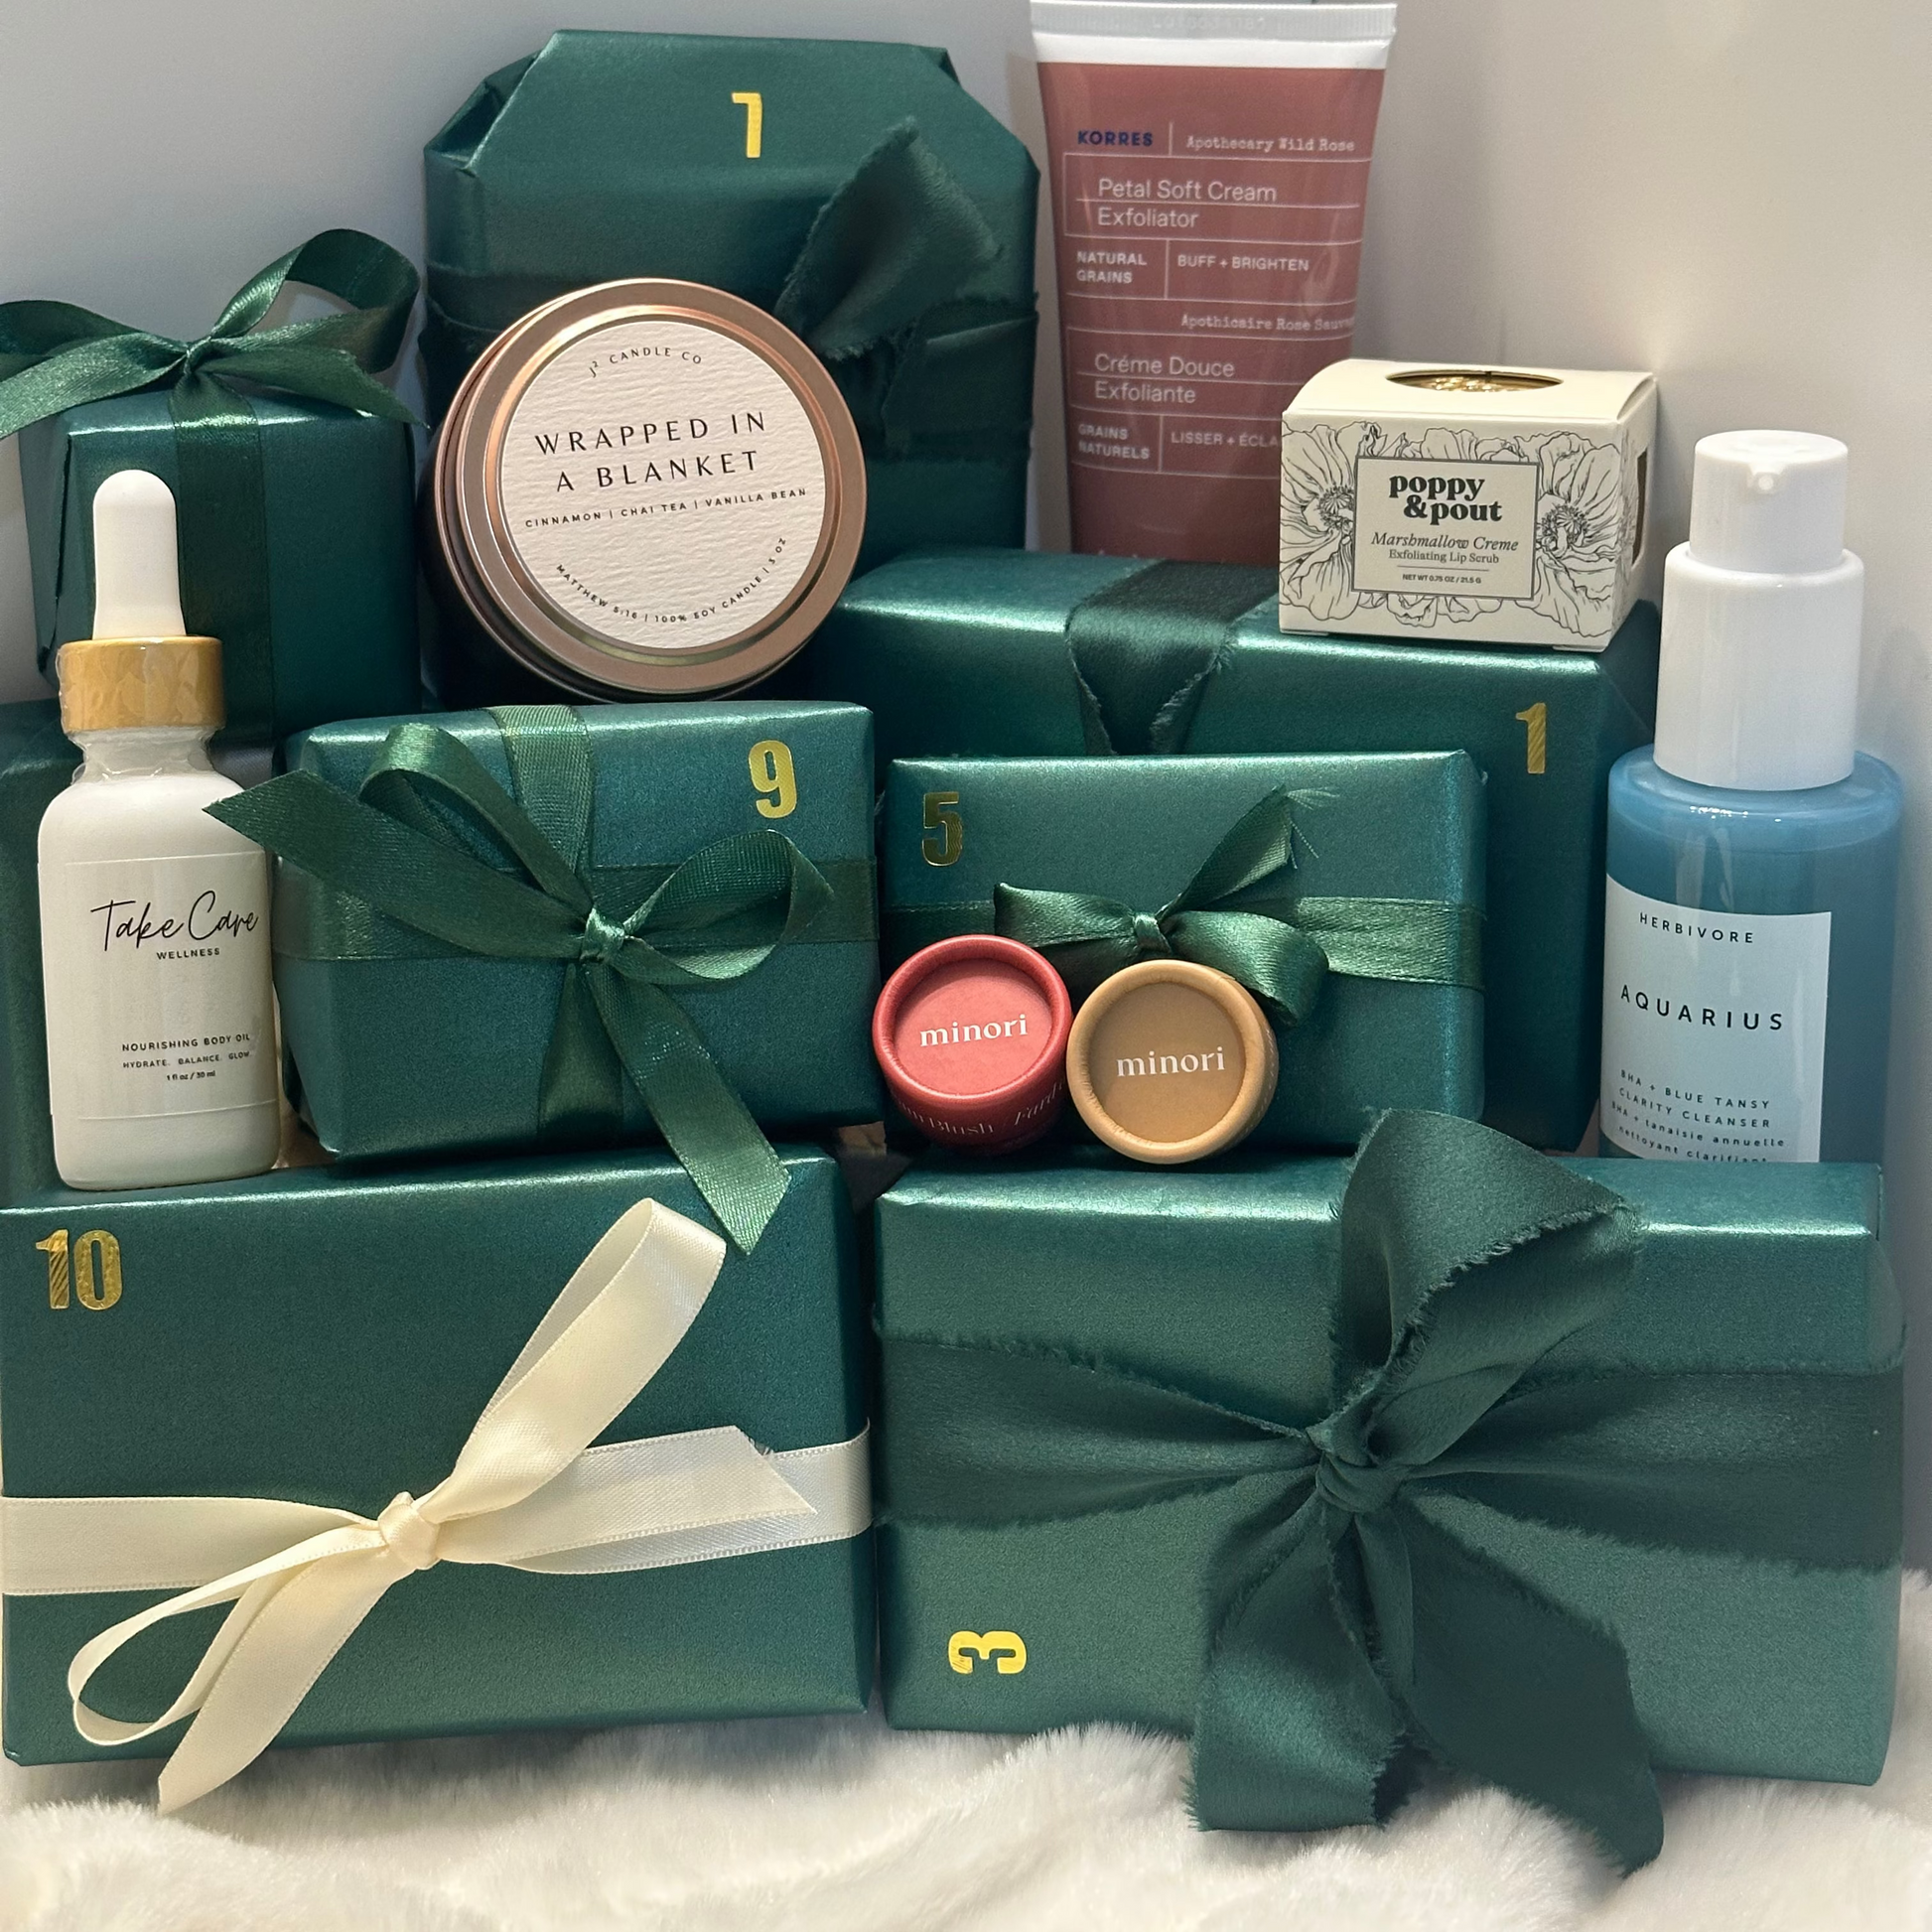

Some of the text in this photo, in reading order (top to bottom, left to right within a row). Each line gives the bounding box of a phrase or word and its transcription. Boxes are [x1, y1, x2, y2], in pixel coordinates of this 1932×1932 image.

[1077, 129, 1154, 147] KORRES
[1186, 136, 1355, 153] Apothecary Wild Rose
[1098, 179, 1277, 202] Petal Soft Cream
[1098, 207, 1199, 228] Exfoliator
[1077, 251, 1148, 265] NATURAL
[1177, 255, 1216, 269] BUFF
[1232, 256, 1310, 272] BRIGHTEN
[1077, 270, 1133, 284] GRAINS
[1181, 314, 1272, 330] Apothicaire
[1276, 318, 1311, 331] Rose
[610, 346, 671, 364] CANDLE
[681, 351, 702, 364] CO
[1170, 356, 1235, 377] Douce
[1095, 380, 1196, 404] Exfoliante
[535, 411, 766, 455] WRAPPED IN
[1078, 424, 1129, 440] GRAINS
[1172, 431, 1222, 446] LISSER
[1239, 433, 1279, 448] ÉCLA
[1078, 442, 1151, 460] NATURELS
[556, 450, 759, 492] A BLANKET
[1388, 475, 1485, 502] poppy
[525, 511, 602, 528] CINNAMON
[621, 506, 655, 517] CHAI
[662, 502, 687, 512] TEA
[705, 493, 764, 508] VANILLA
[771, 487, 807, 500] BEAN
[1370, 531, 1519, 552] Marshmallow Creme
[1388, 548, 1500, 564] Exfoliating Lip Scrub
[556, 564, 609, 608] MATTHEW
[654, 615, 687, 623] 100%
[693, 606, 716, 620] SOY
[722, 575, 762, 609] CANDLE
[774, 537, 786, 554] OZ
[1515, 702, 1547, 774] 1
[748, 739, 798, 820] 9
[921, 790, 963, 867] 5
[90, 890, 260, 951] Take Care
[1639, 910, 1754, 944] HERBIVORE
[156, 946, 221, 961] WELLNESS
[1620, 983, 1783, 1032] AQUARIUS
[918, 1014, 1029, 1047] minori
[121, 1033, 251, 1053] NOURISHING BODY OIL
[122, 1058, 172, 1069] HYDRATE.
[1115, 1045, 1225, 1077] minori
[206, 1069, 216, 1078] ml
[1620, 1068, 1643, 1087] BHA
[1665, 1086, 1705, 1104] BLUE
[1715, 1096, 1770, 1110] TANSY
[1619, 1086, 1771, 1129] CLARITY CLEANSER
[1611, 1100, 1629, 1117] BHA
[1645, 1119, 1704, 1142] tanaisie
[1713, 1133, 1785, 1148] annuelle
[1618, 1124, 1680, 1155] nettoyant
[35, 1228, 123, 1311] 10
[948, 1630, 1028, 1675] 3
